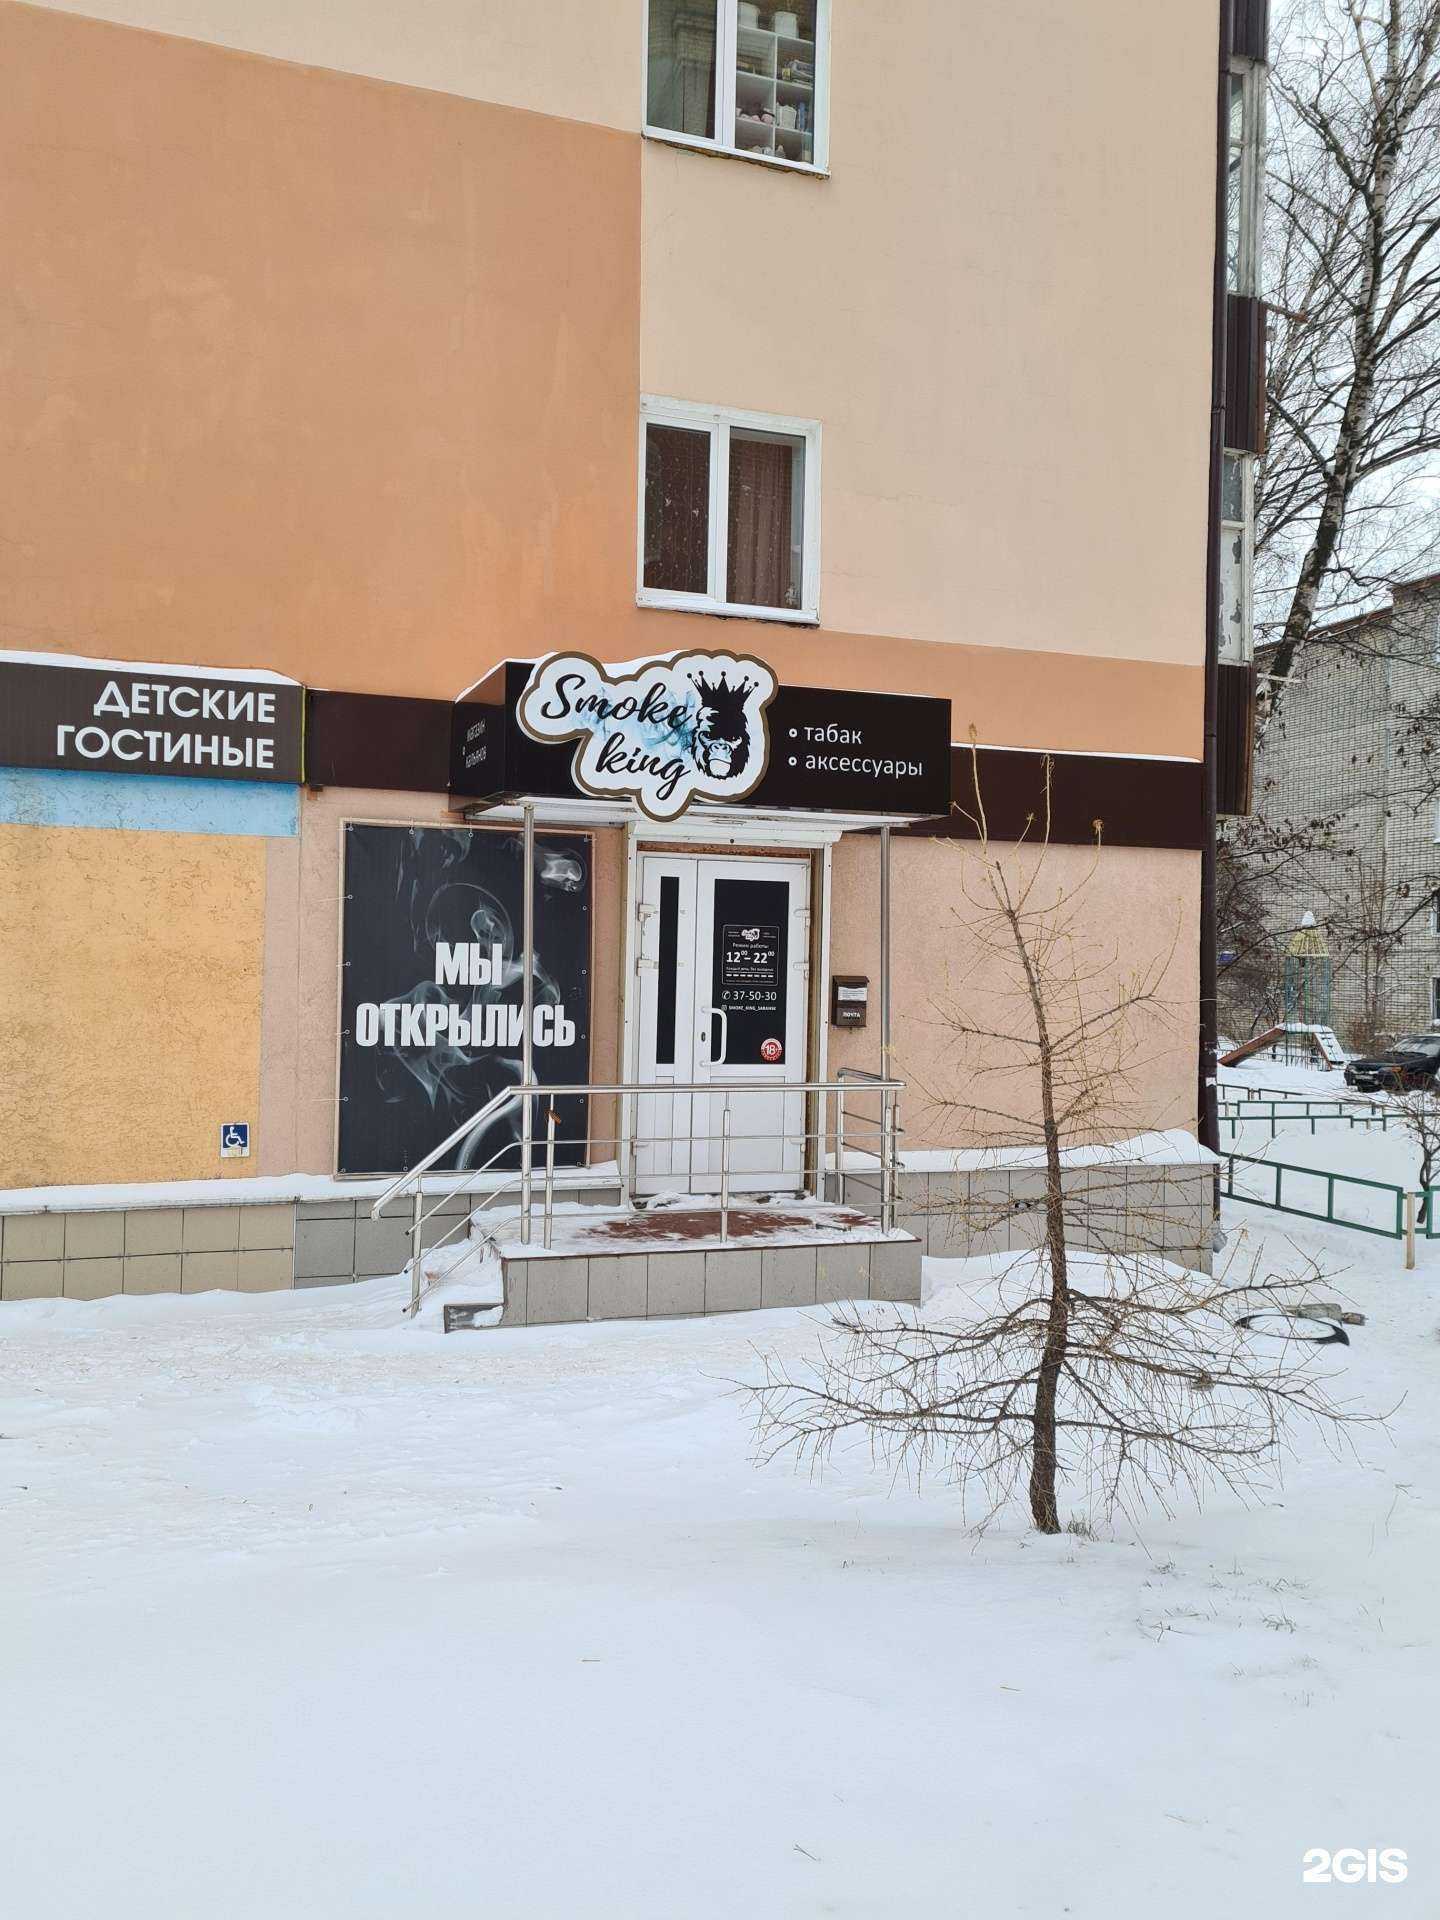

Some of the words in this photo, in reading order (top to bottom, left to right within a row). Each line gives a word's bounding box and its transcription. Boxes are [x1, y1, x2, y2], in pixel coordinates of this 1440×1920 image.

[93, 680, 277, 724] ДЕТСКИЕ
[541, 673, 694, 729] Smoke
[56, 724, 275, 769] ГОСТИНЫЕ
[804, 723, 862, 745] табак
[595, 732, 691, 800] king
[805, 754, 923, 779] аксессуары
[435, 942, 503, 986] МЫ
[733, 990, 777, 1001] 37-50-30
[355, 1002, 576, 1047] ОТКРЫЛИСЬ
